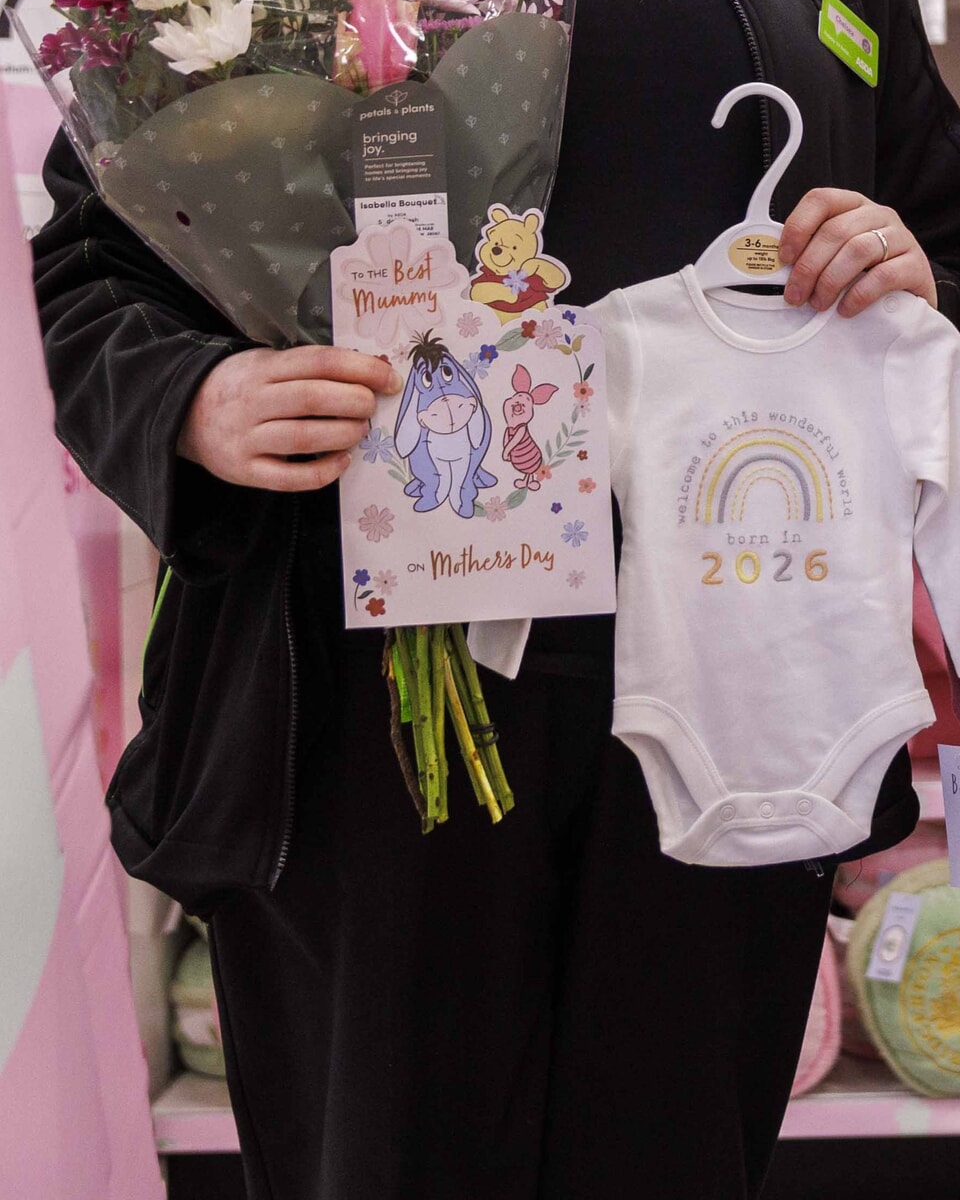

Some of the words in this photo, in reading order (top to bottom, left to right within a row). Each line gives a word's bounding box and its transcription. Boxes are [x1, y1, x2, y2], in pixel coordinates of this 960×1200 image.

[360, 107, 392, 121] petals
[401, 103, 435, 116] plants
[363, 130, 417, 145] bringing
[362, 143, 385, 158] joy.
[360, 201, 396, 210] Isabella
[399, 199, 437, 208] Bouquet
[744, 238, 761, 248] 3-6
[367, 268, 388, 279] THE
[394, 252, 433, 285] Best
[352, 288, 437, 318] Mummy
[678, 455, 702, 524] welcome
[701, 431, 717, 448] to
[722, 411, 759, 430] this
[768, 411, 840, 461] wonderful
[837, 469, 852, 517] world
[727, 532, 769, 545] born
[782, 530, 802, 543] in
[407, 562, 425, 573] ON
[430, 544, 517, 580] Mother's
[521, 542, 555, 572] Day
[701, 548, 829, 585] 2026
